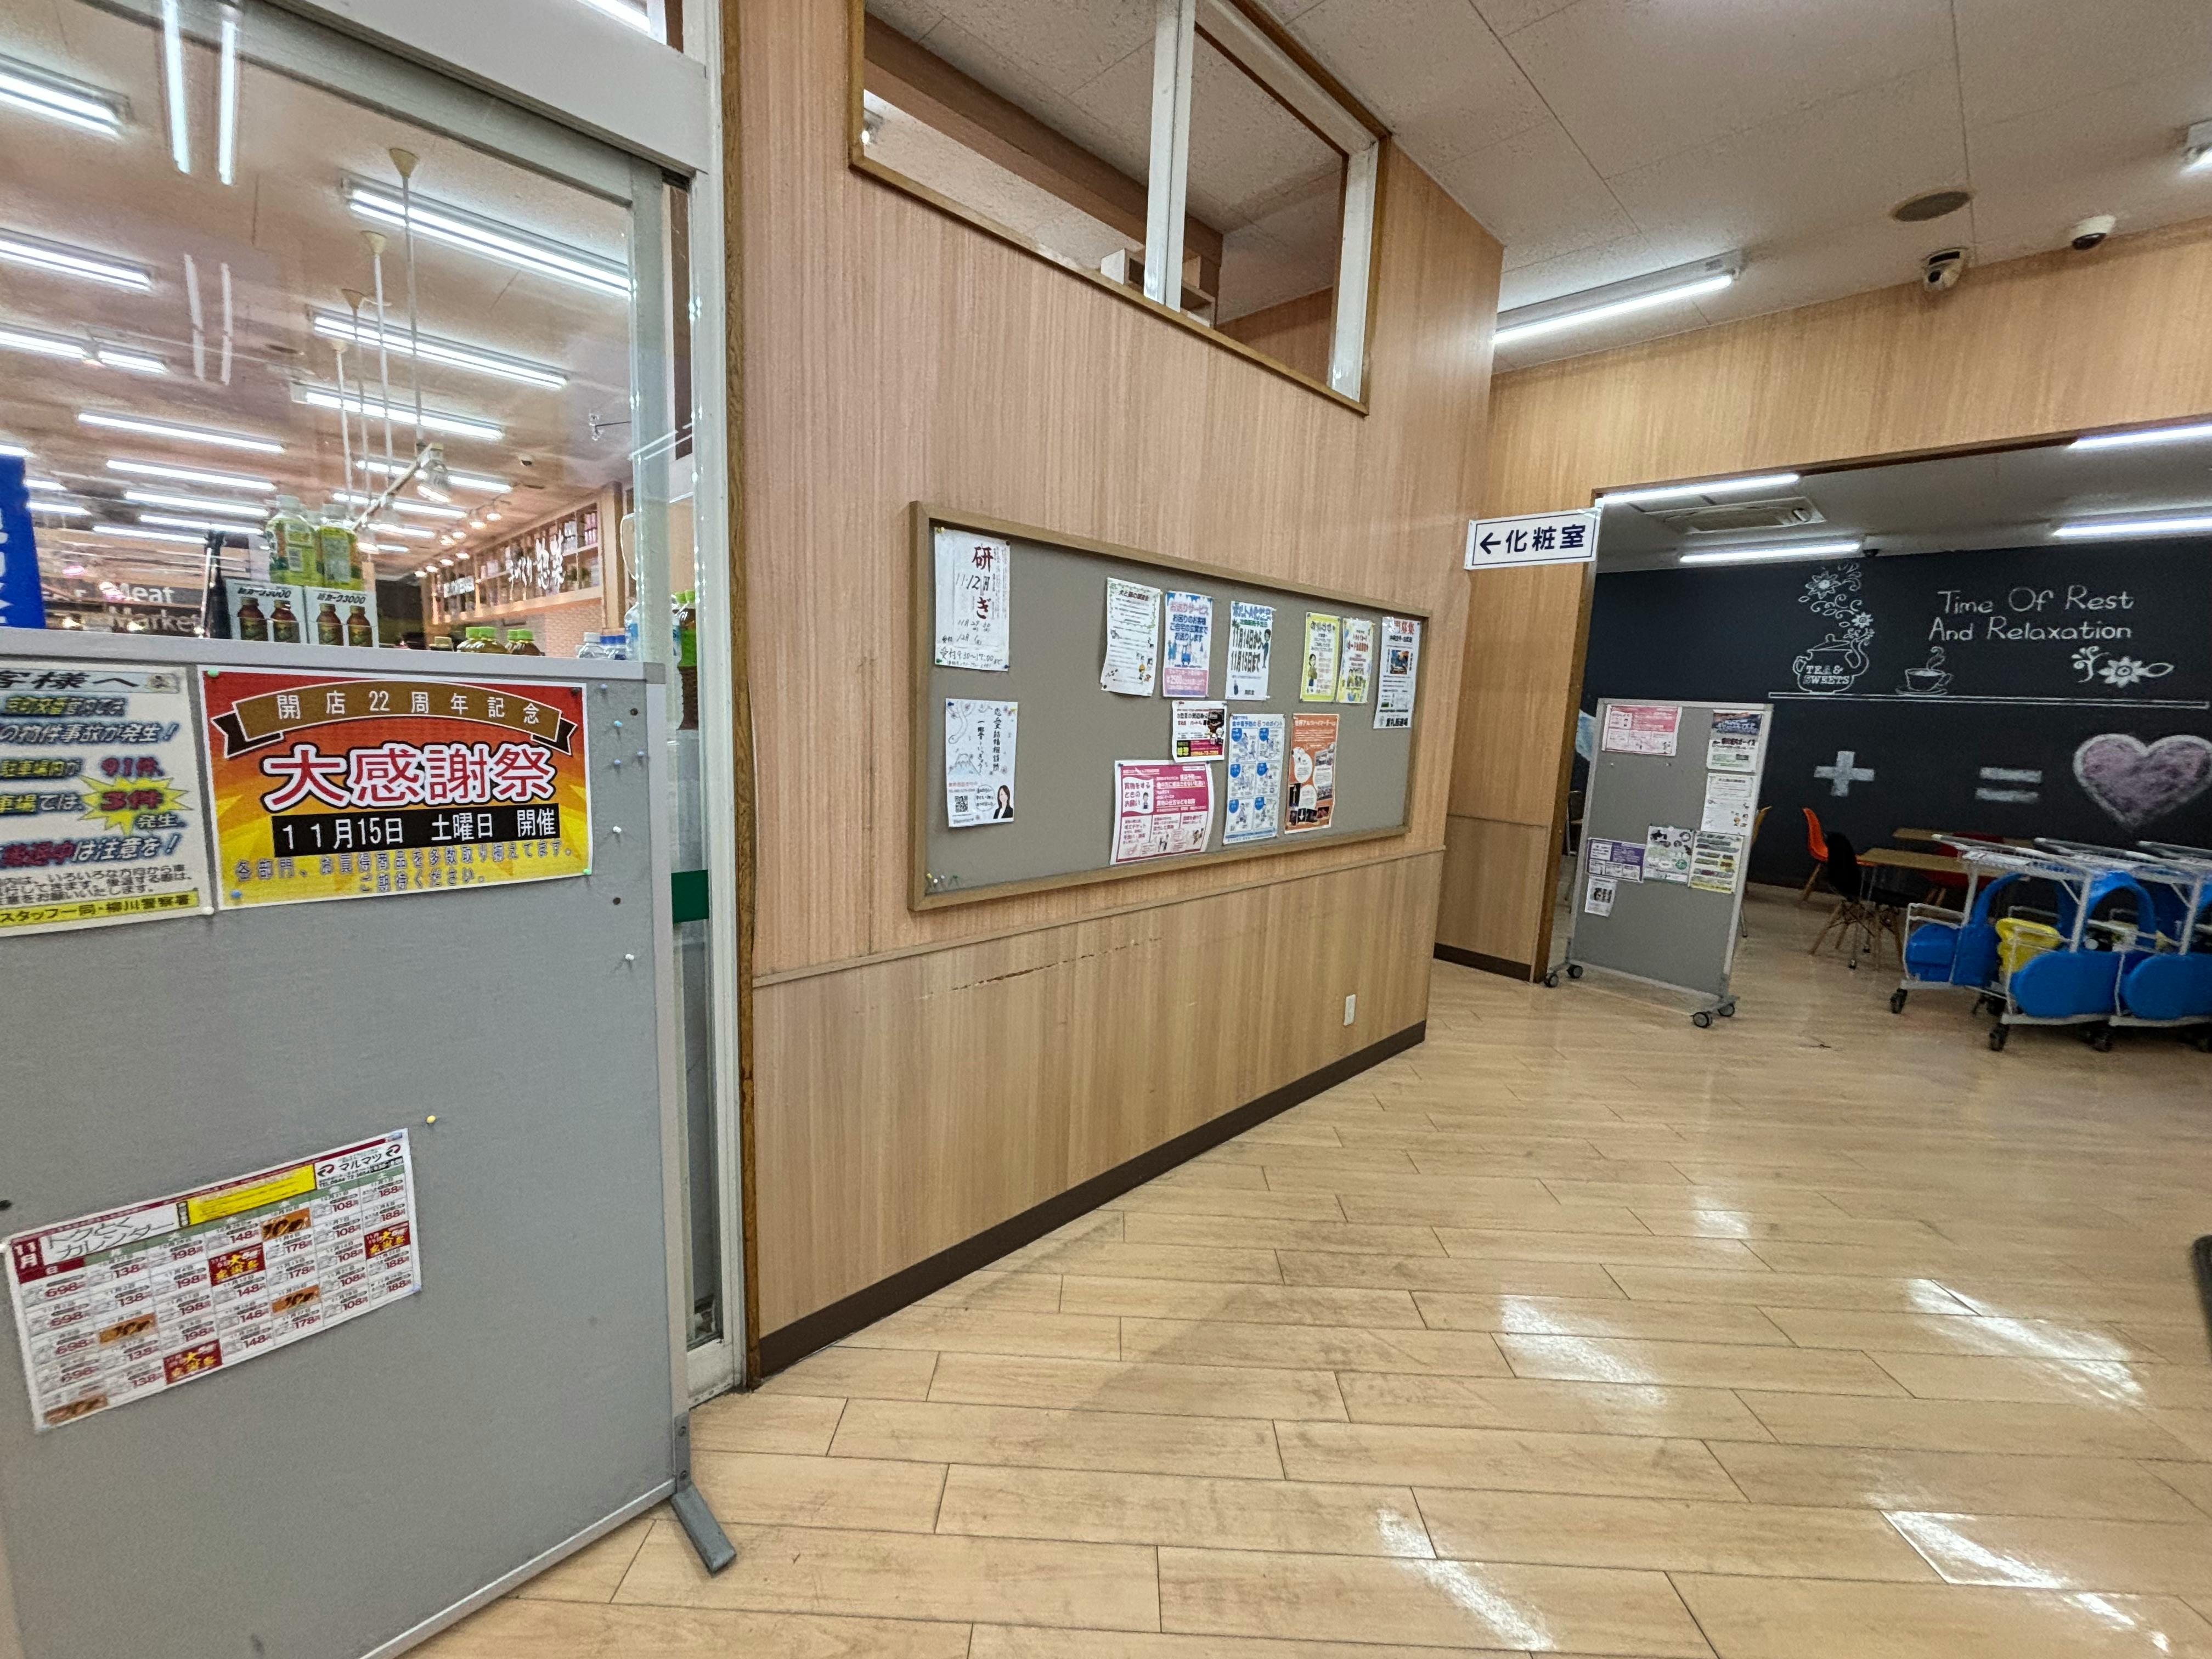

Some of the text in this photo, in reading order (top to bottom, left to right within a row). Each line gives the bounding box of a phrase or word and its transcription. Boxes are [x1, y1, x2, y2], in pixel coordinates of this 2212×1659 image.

[1505, 524, 1586, 554] 化粧室
[972, 546, 994, 573] 研
[976, 596, 991, 619] ぎ
[1937, 584, 2135, 614] Time Of Rest
[1928, 615, 2132, 641] And Relaxation
[1802, 675, 1850, 685] SWEETS
[1805, 665, 1833, 675] TEA
[276, 690, 540, 725] 開店22周年記念
[263, 742, 555, 811] 大感謝祭
[431, 814, 493, 841] 土曜日
[516, 808, 556, 837] 開催
[339, 1153, 382, 1171] マルマツ
[56, 1222, 175, 1261] カレンダー
